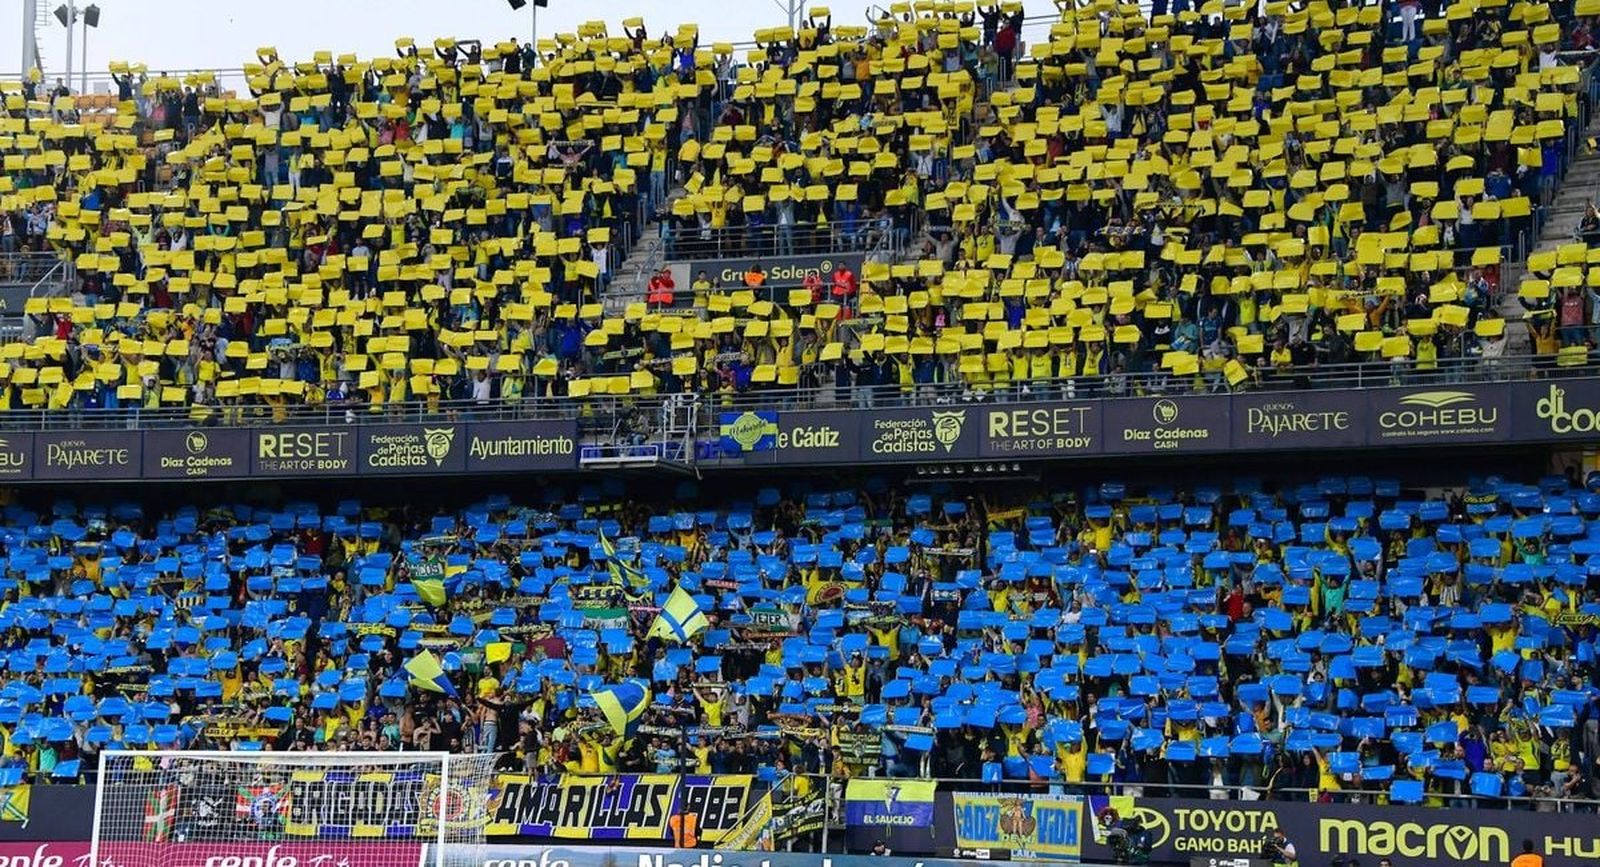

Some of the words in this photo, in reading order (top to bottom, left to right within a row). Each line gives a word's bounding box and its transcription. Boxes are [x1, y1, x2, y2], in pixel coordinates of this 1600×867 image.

[721, 268, 768, 281] Gruo
[874, 418, 927, 429] Federación
[989, 406, 1092, 438] RESET
[1247, 407, 1350, 438] PAJARETE
[1379, 407, 1498, 429] COHEBU
[370, 434, 419, 444] Federación
[791, 426, 839, 449] Cádiz
[894, 426, 933, 440] Peñas
[1123, 428, 1151, 441] Díaz
[1154, 427, 1208, 440] Cadenas
[259, 432, 349, 458] RESET
[388, 442, 425, 454] Peñas
[469, 435, 573, 460] Ayuntamiento
[872, 439, 936, 454] Cadistas
[990, 441, 1011, 451] THE
[1012, 440, 1035, 451] ART
[1037, 438, 1053, 449] OF
[1056, 437, 1091, 448] BODY
[1153, 440, 1178, 449] CASH
[47, 443, 129, 470] PAJARETE
[160, 456, 183, 468] Díaz
[186, 455, 233, 467] Cadenas
[368, 453, 427, 467] Cadistas
[186, 467, 207, 476] CASH
[259, 461, 278, 471] THE
[279, 460, 300, 470] ART
[300, 459, 315, 470] OF
[317, 459, 348, 469] BODY
[290, 781, 422, 825] BRIGADAS
[494, 783, 671, 828] AMARILLAS
[863, 814, 875, 824] EL
[876, 814, 914, 826] SAUCEJO
[1174, 808, 1279, 833] TOYOTA
[1174, 836, 1224, 852] GAMO
[1319, 818, 1509, 863] macron
